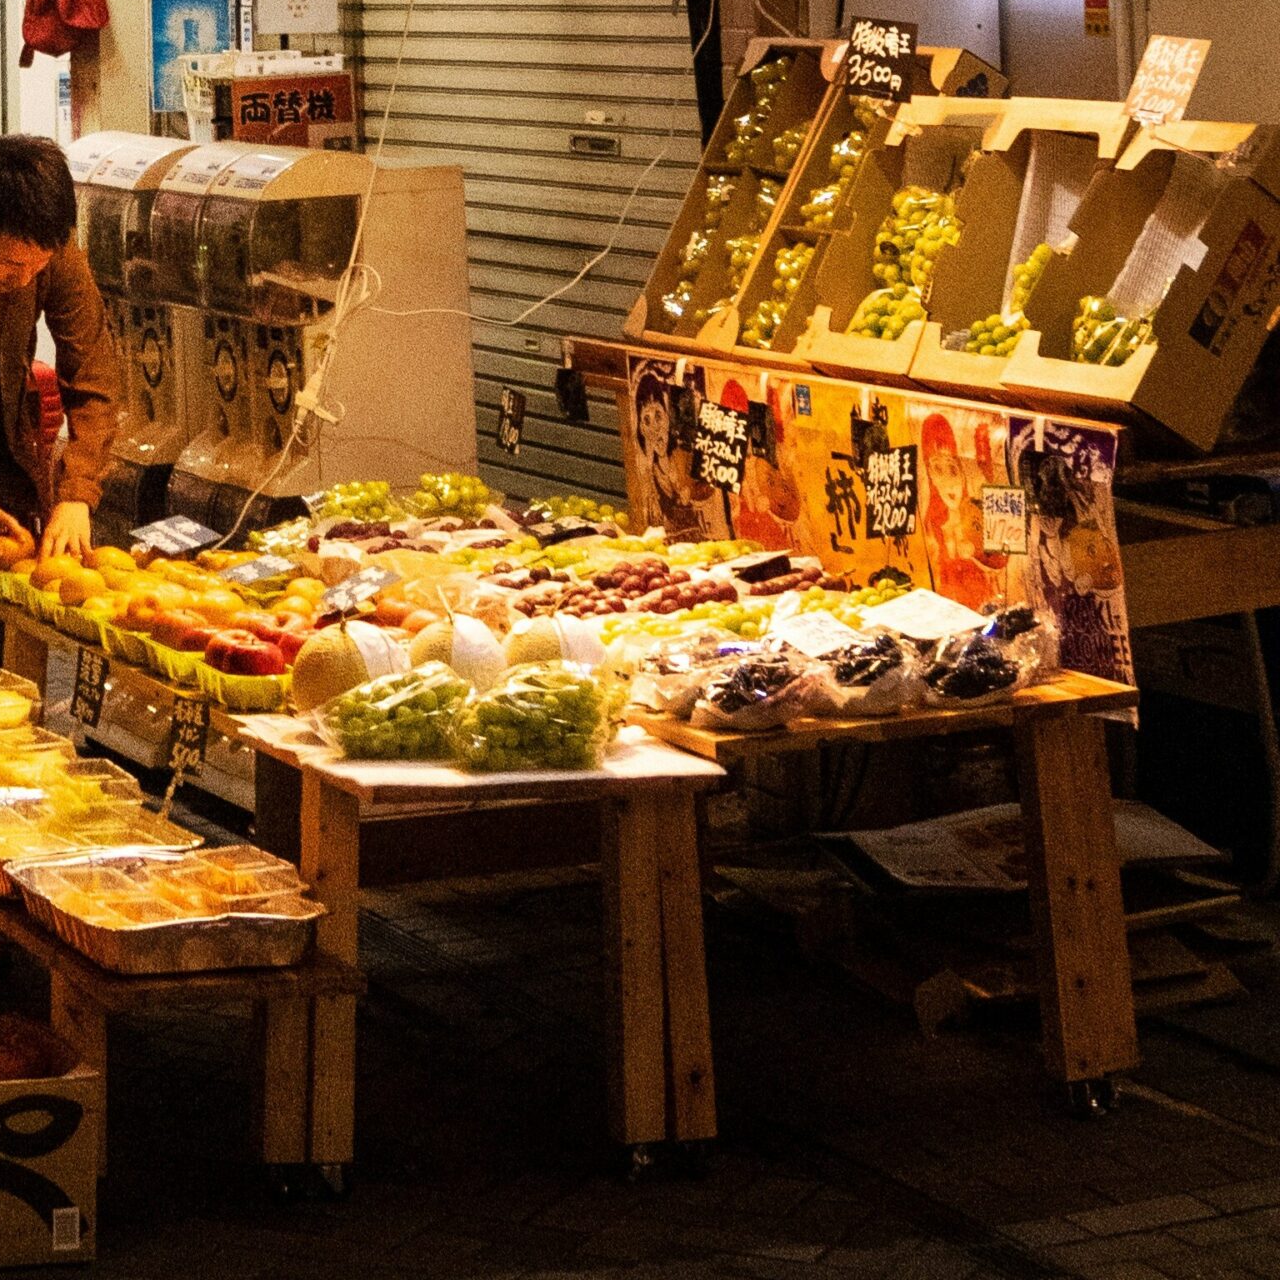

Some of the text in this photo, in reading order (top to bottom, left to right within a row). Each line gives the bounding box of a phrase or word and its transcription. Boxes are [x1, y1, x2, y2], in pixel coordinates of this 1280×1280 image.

[847, 54, 903, 92] 3500円
[239, 87, 337, 126] 両替機
